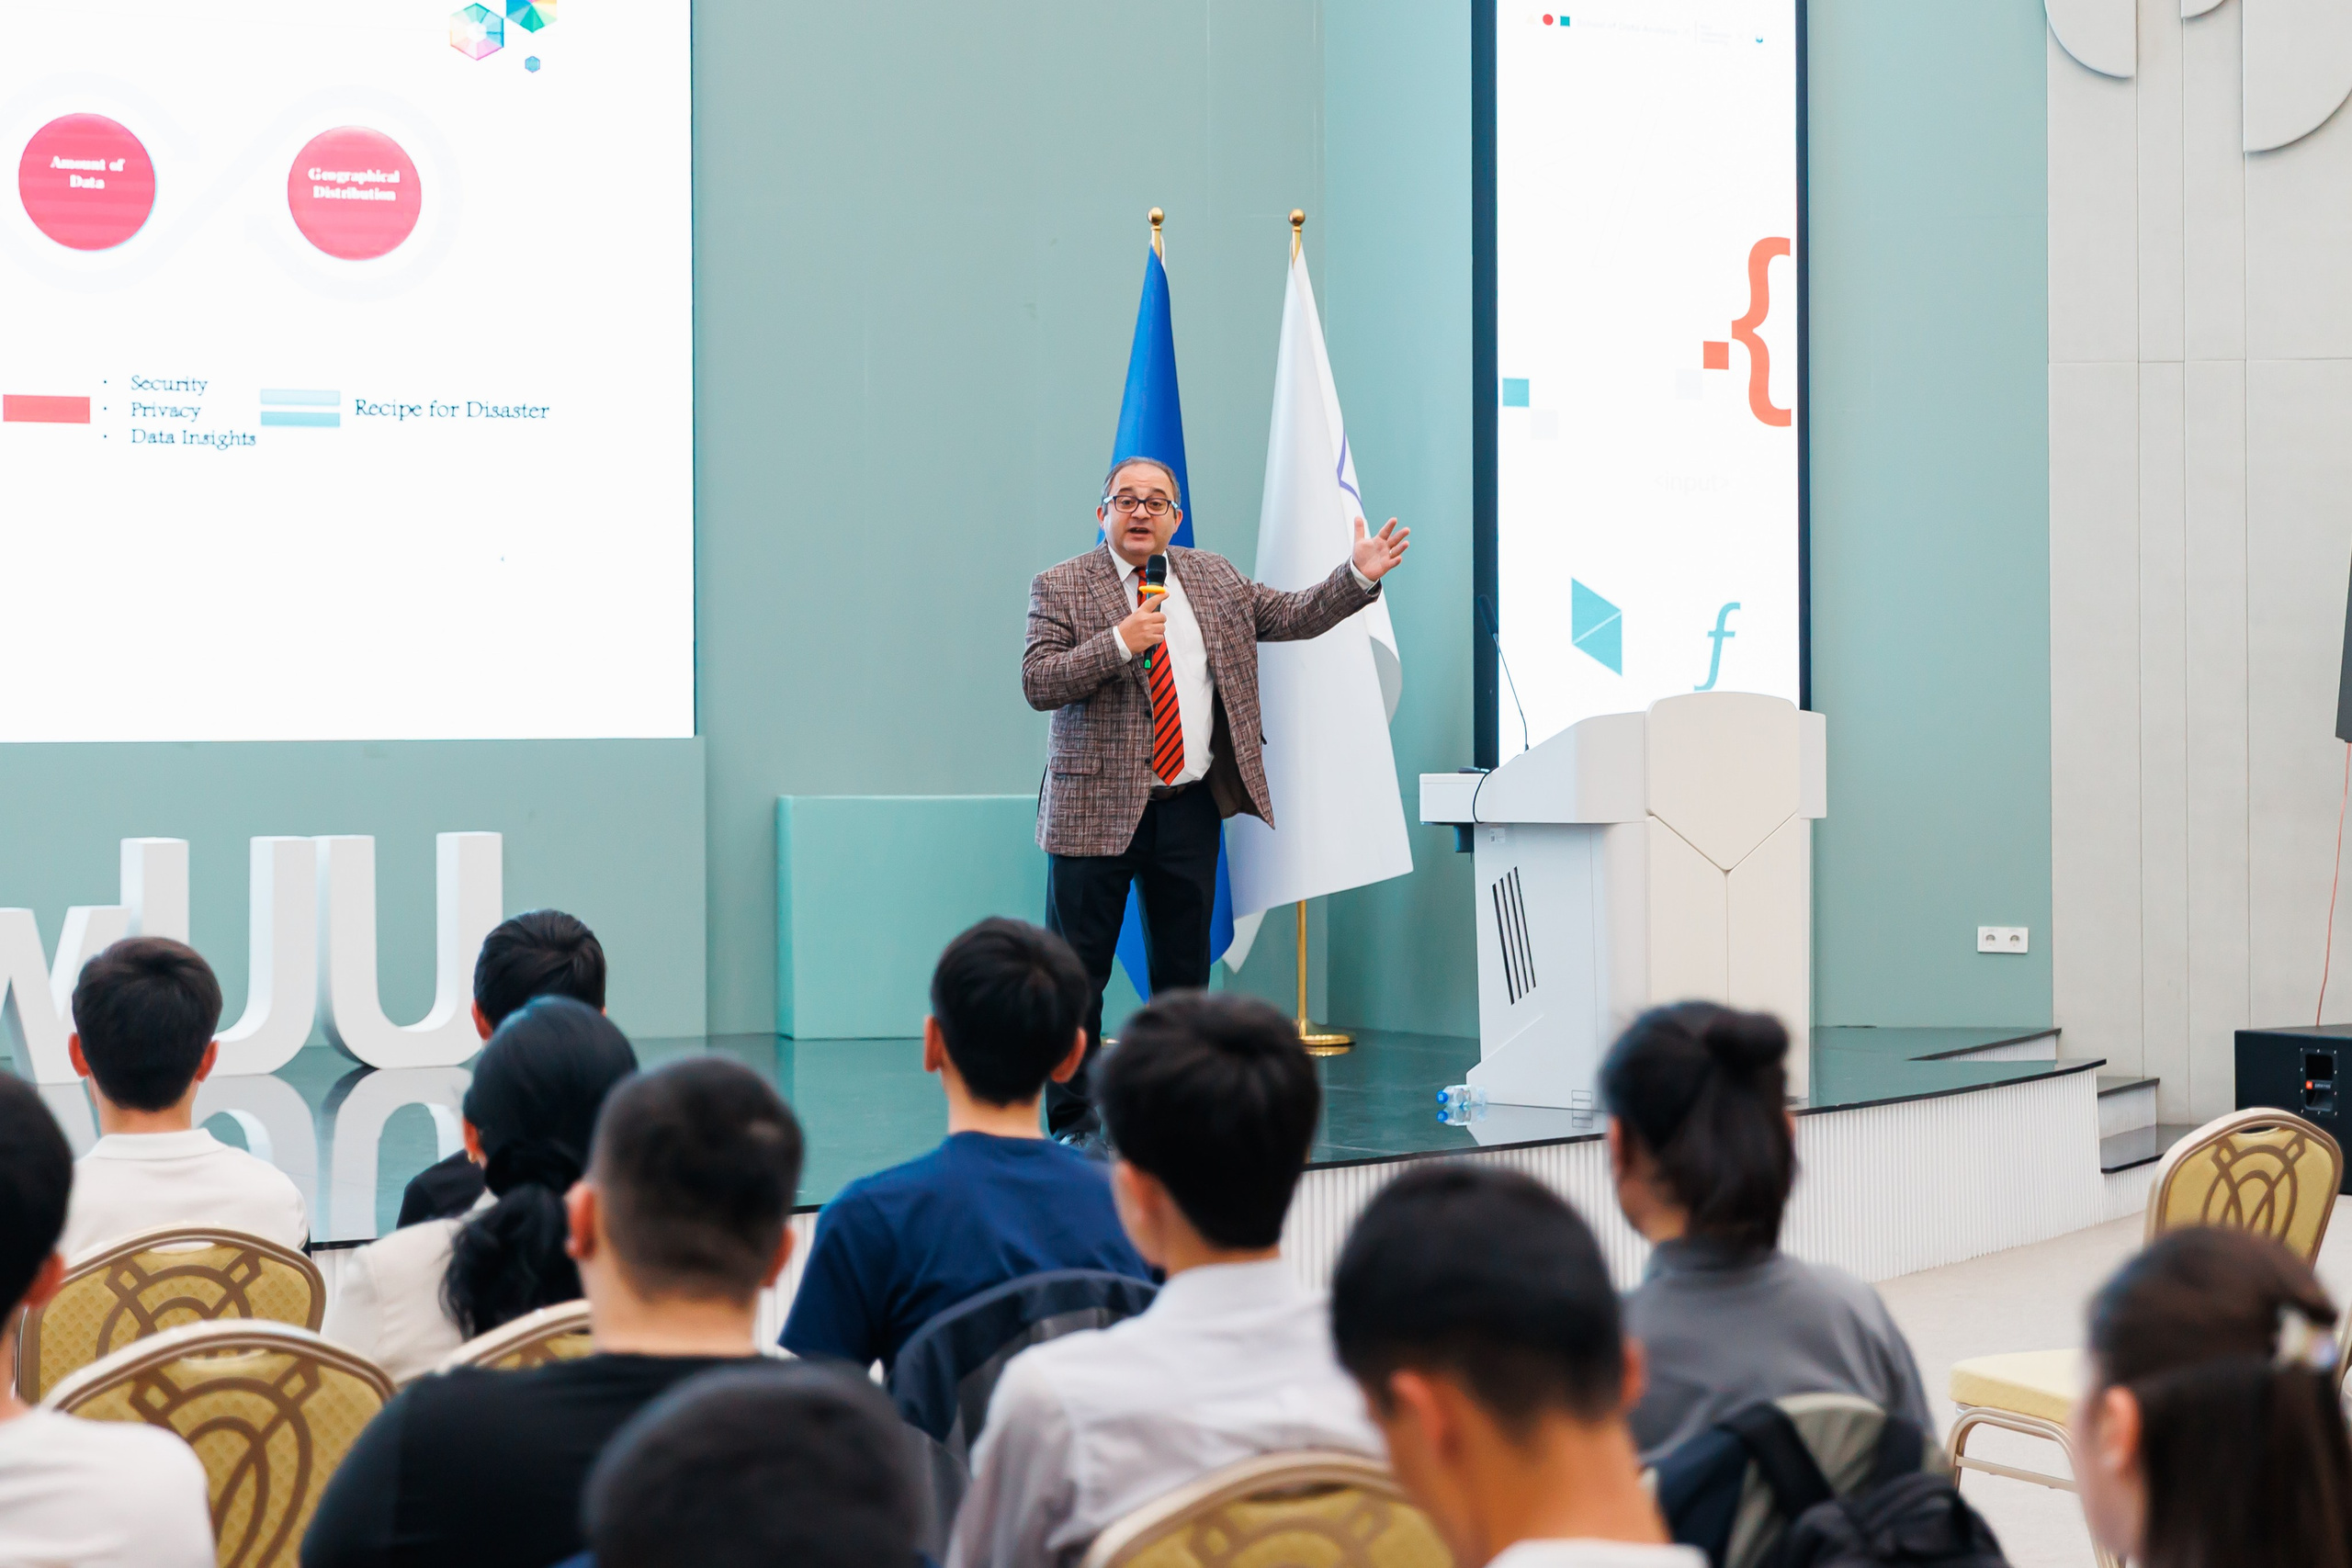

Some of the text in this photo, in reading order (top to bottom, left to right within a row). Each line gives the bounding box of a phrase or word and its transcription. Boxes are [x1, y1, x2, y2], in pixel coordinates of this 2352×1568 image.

[50, 155, 126, 172] Amount of
[70, 175, 106, 189] Data
[308, 167, 401, 185] Geographical
[313, 186, 396, 201] Distribution
[130, 375, 208, 397] Security
[130, 401, 201, 423] Privacy
[355, 399, 550, 421] Recipe for Disaster
[131, 428, 256, 450] Data Insights
